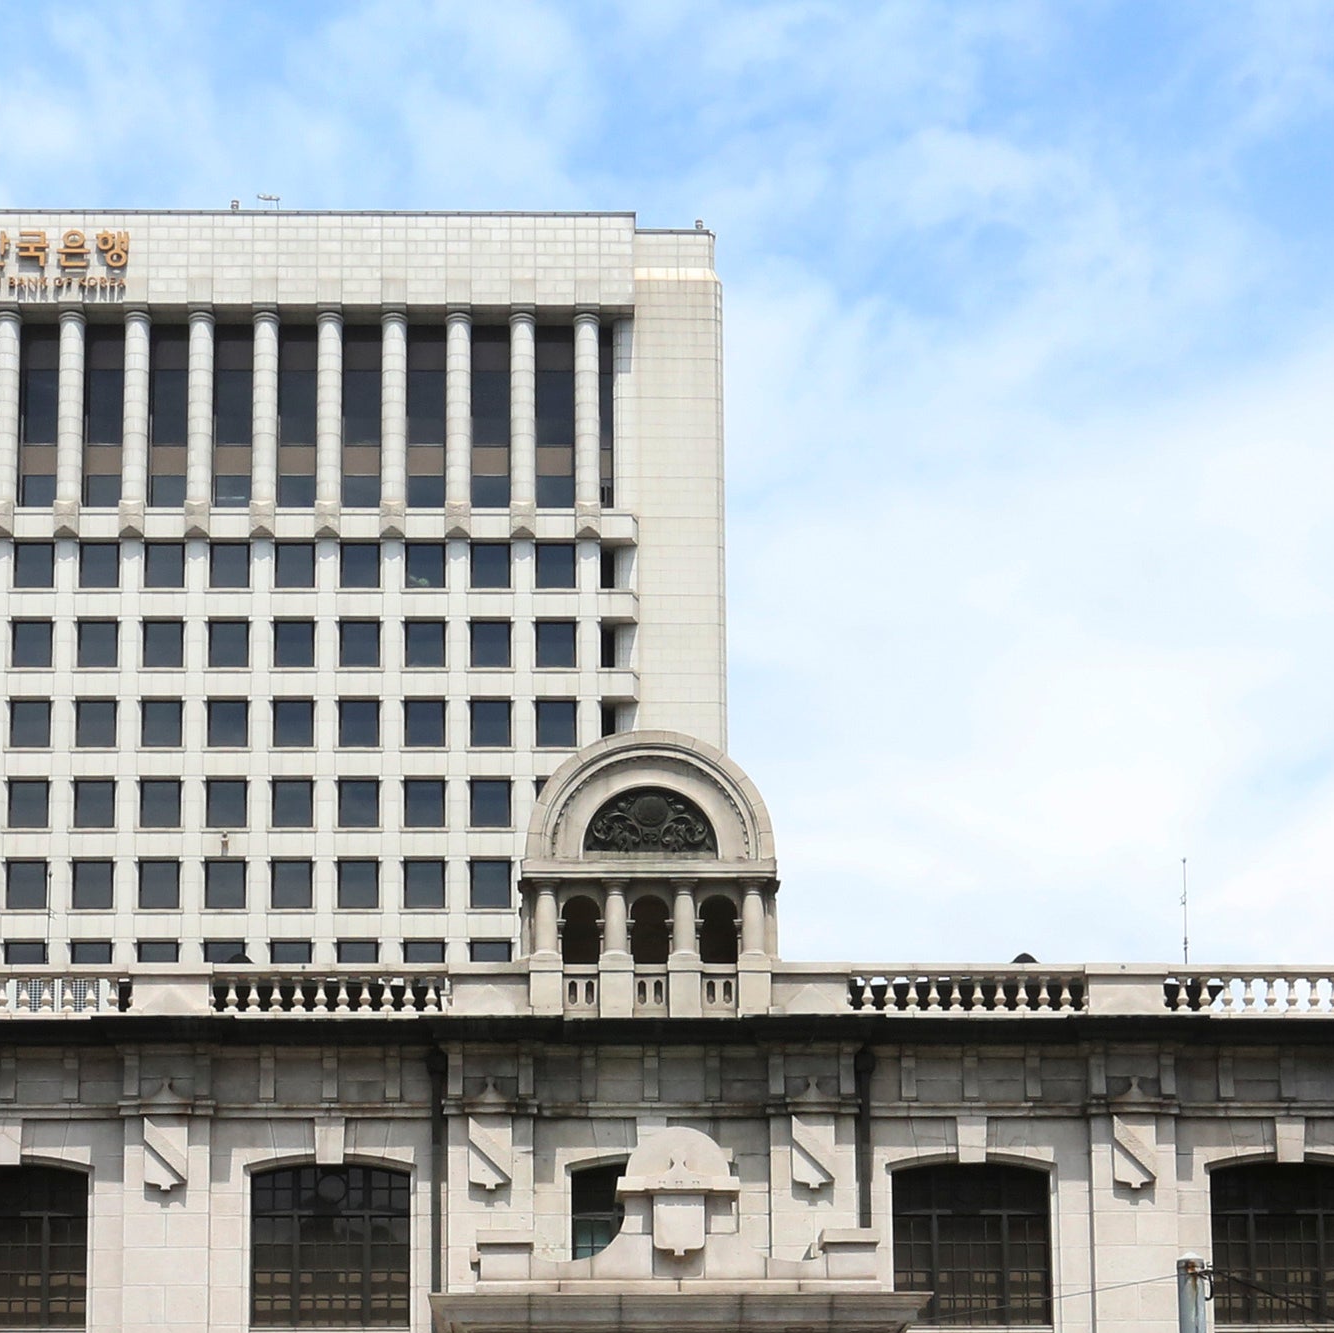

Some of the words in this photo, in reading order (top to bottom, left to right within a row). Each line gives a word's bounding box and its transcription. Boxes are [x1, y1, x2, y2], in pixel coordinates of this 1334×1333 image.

[9, 277, 47, 288] BANK
[54, 277, 72, 288] OF
[78, 277, 126, 288] KOREA
